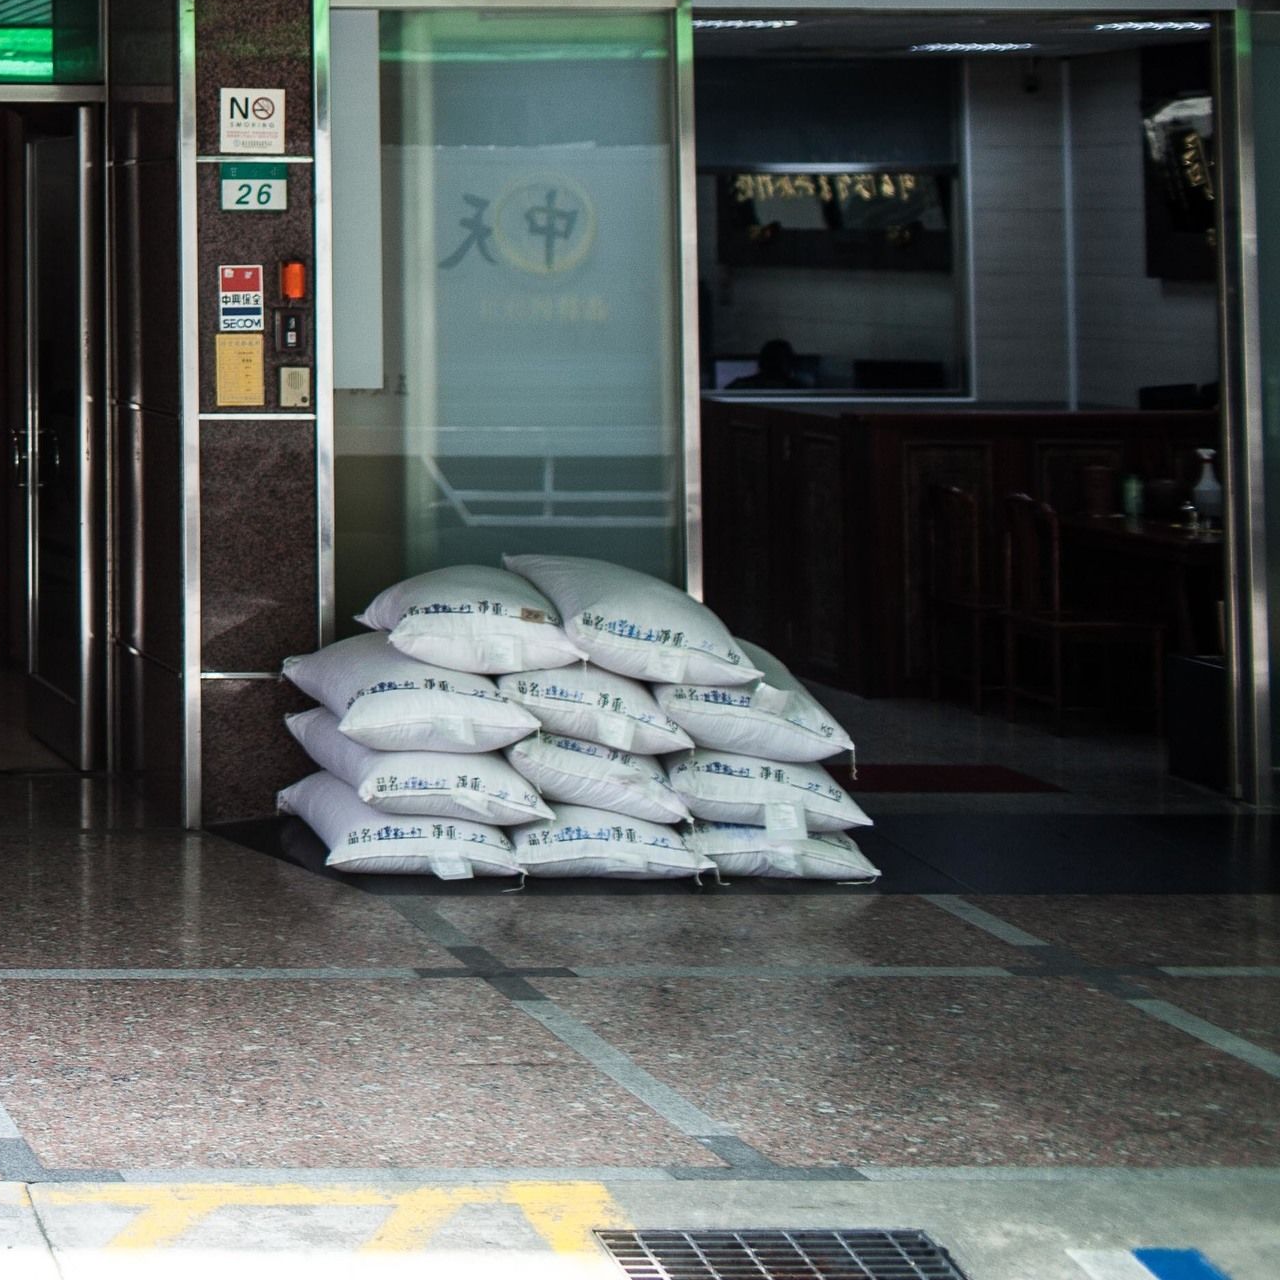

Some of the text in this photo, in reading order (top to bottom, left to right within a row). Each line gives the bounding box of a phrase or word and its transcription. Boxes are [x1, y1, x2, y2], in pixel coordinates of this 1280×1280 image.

[235, 183, 273, 205] 26
[221, 293, 261, 306] 中興保全
[222, 318, 262, 329] SECOM
[727, 649, 742, 664] kg
[820, 722, 834, 737] kg
[376, 775, 404, 792] 品名:
[829, 786, 843, 800] kg
[348, 828, 377, 844] 品名:
